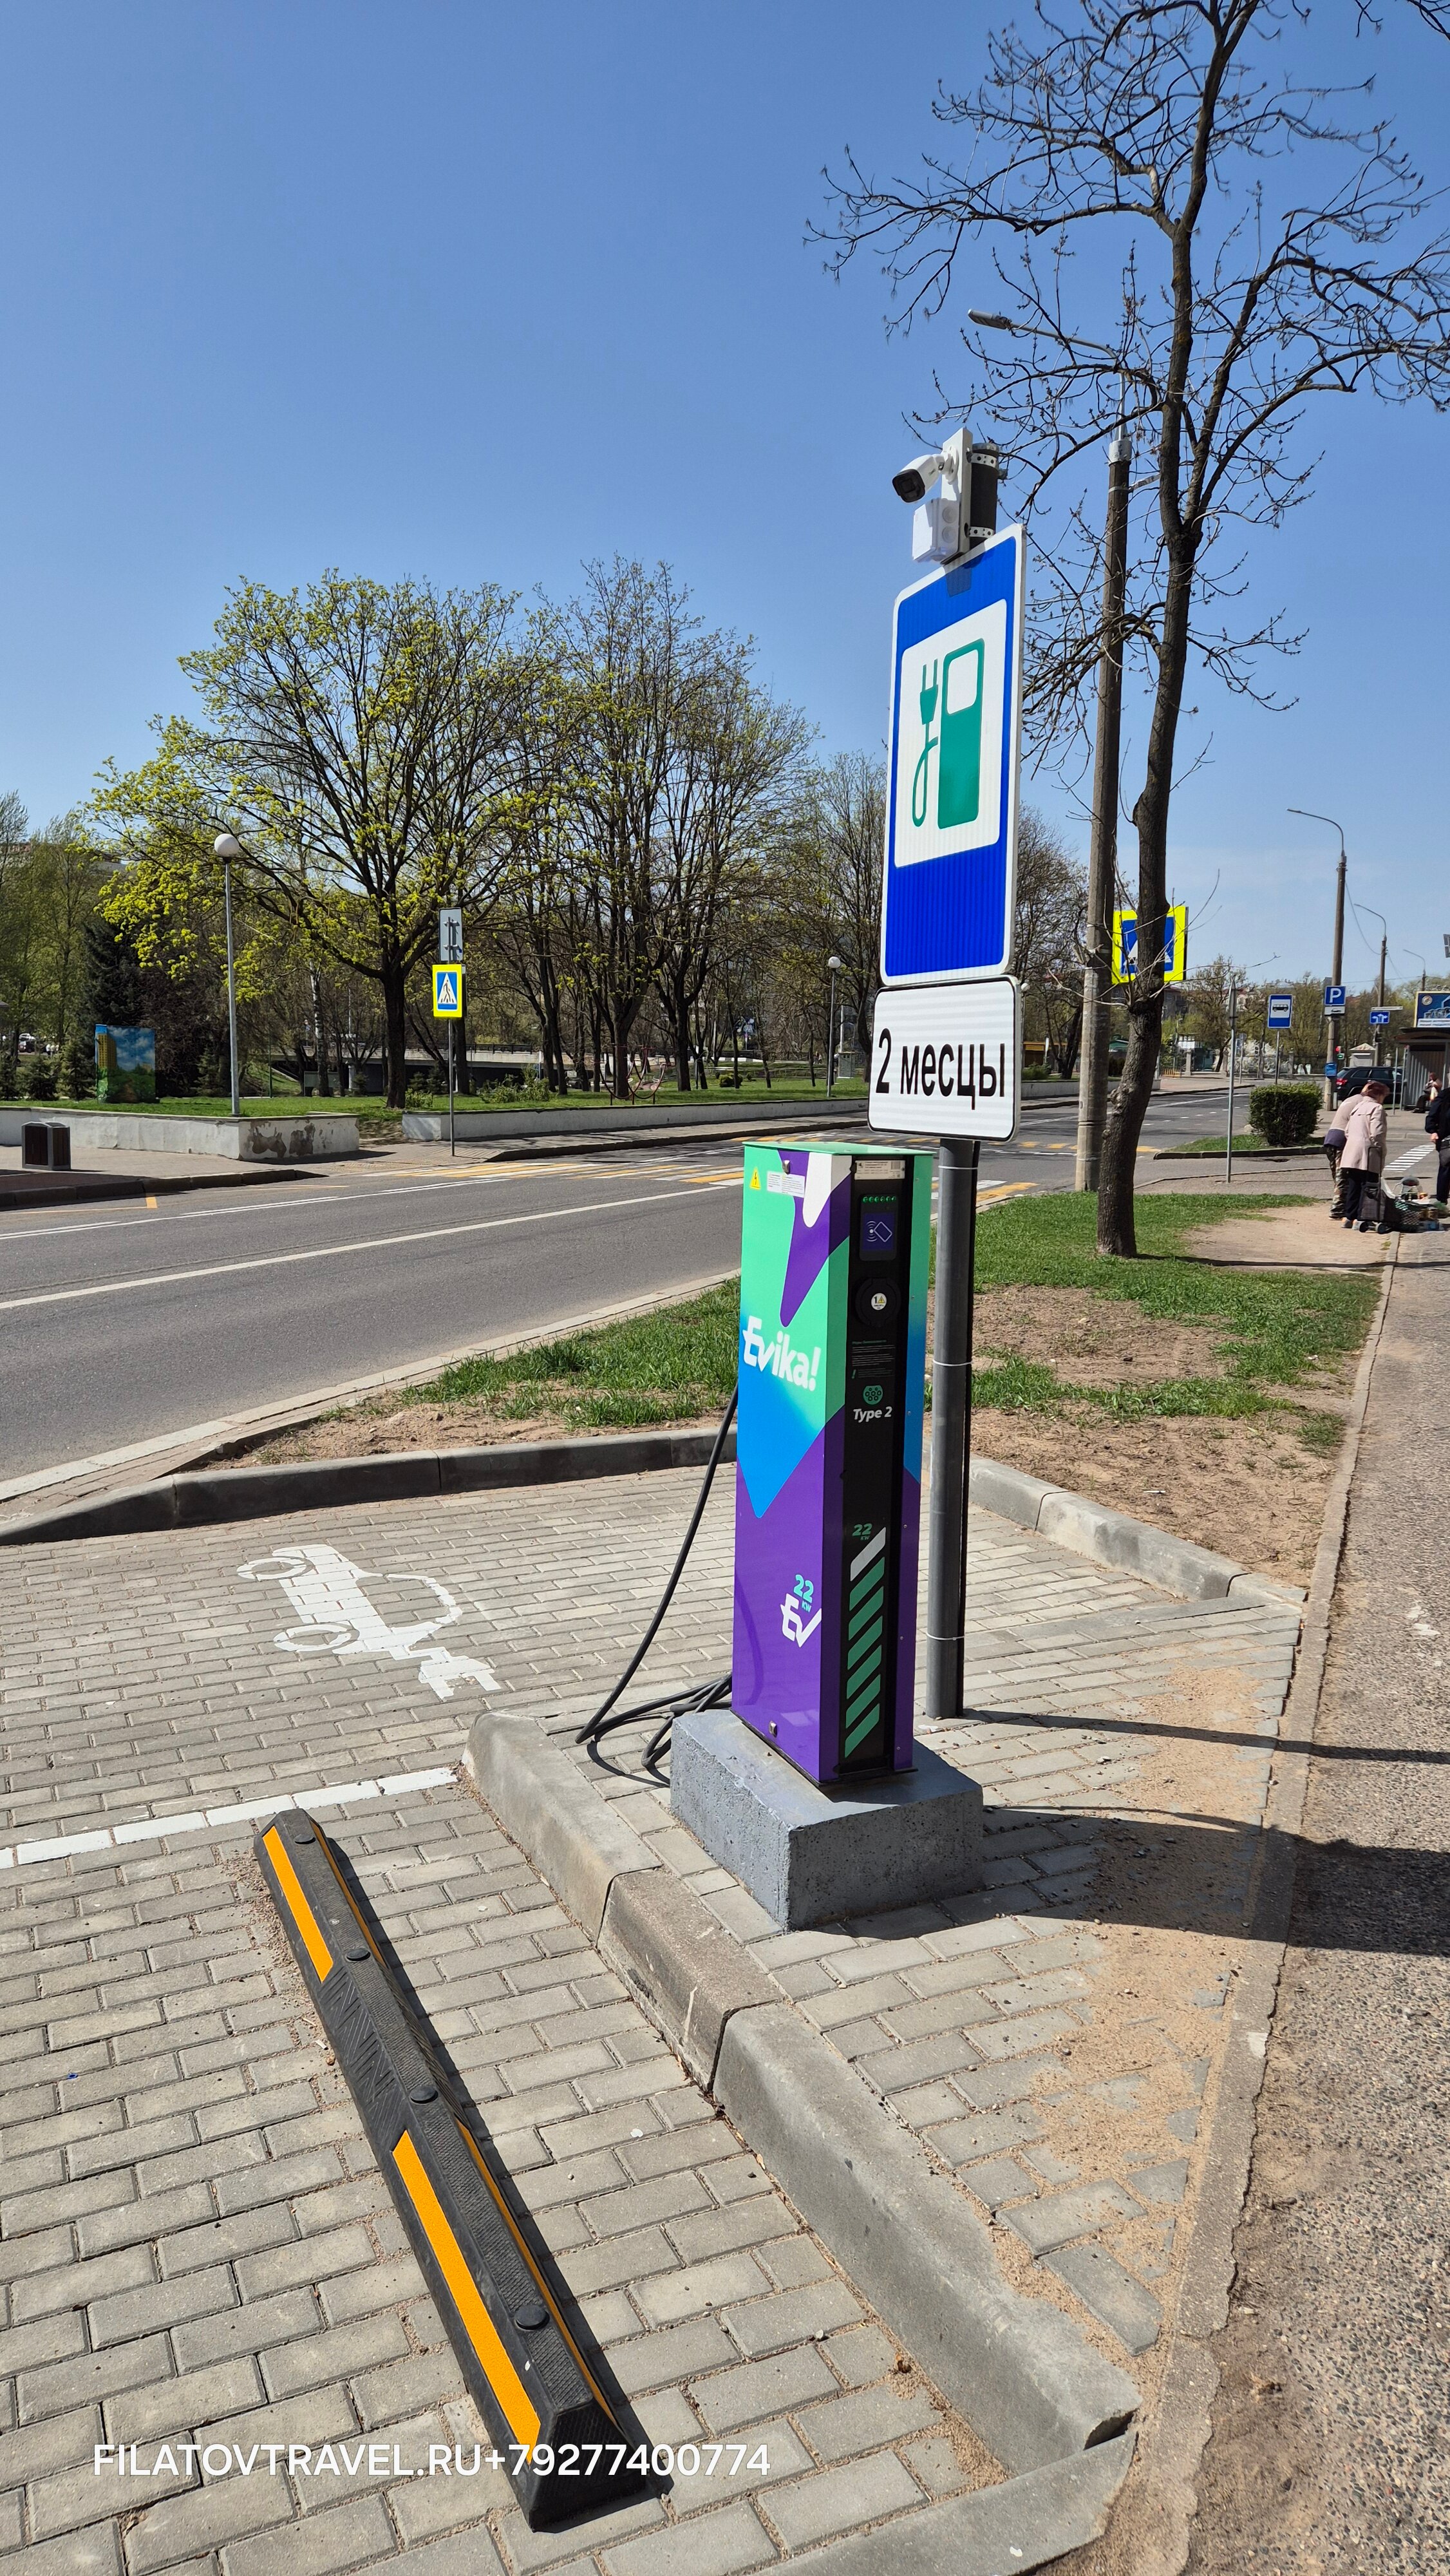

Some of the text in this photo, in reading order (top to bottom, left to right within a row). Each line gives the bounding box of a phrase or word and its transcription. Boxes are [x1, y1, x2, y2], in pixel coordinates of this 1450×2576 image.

[1329, 987, 1342, 1003] P
[875, 1028, 1005, 1110] 2 месцы
[742, 1315, 822, 1392] Evika!
[853, 1406, 893, 1423] Type 2
[852, 1523, 872, 1537] 22
[793, 1574, 814, 1604] 22
